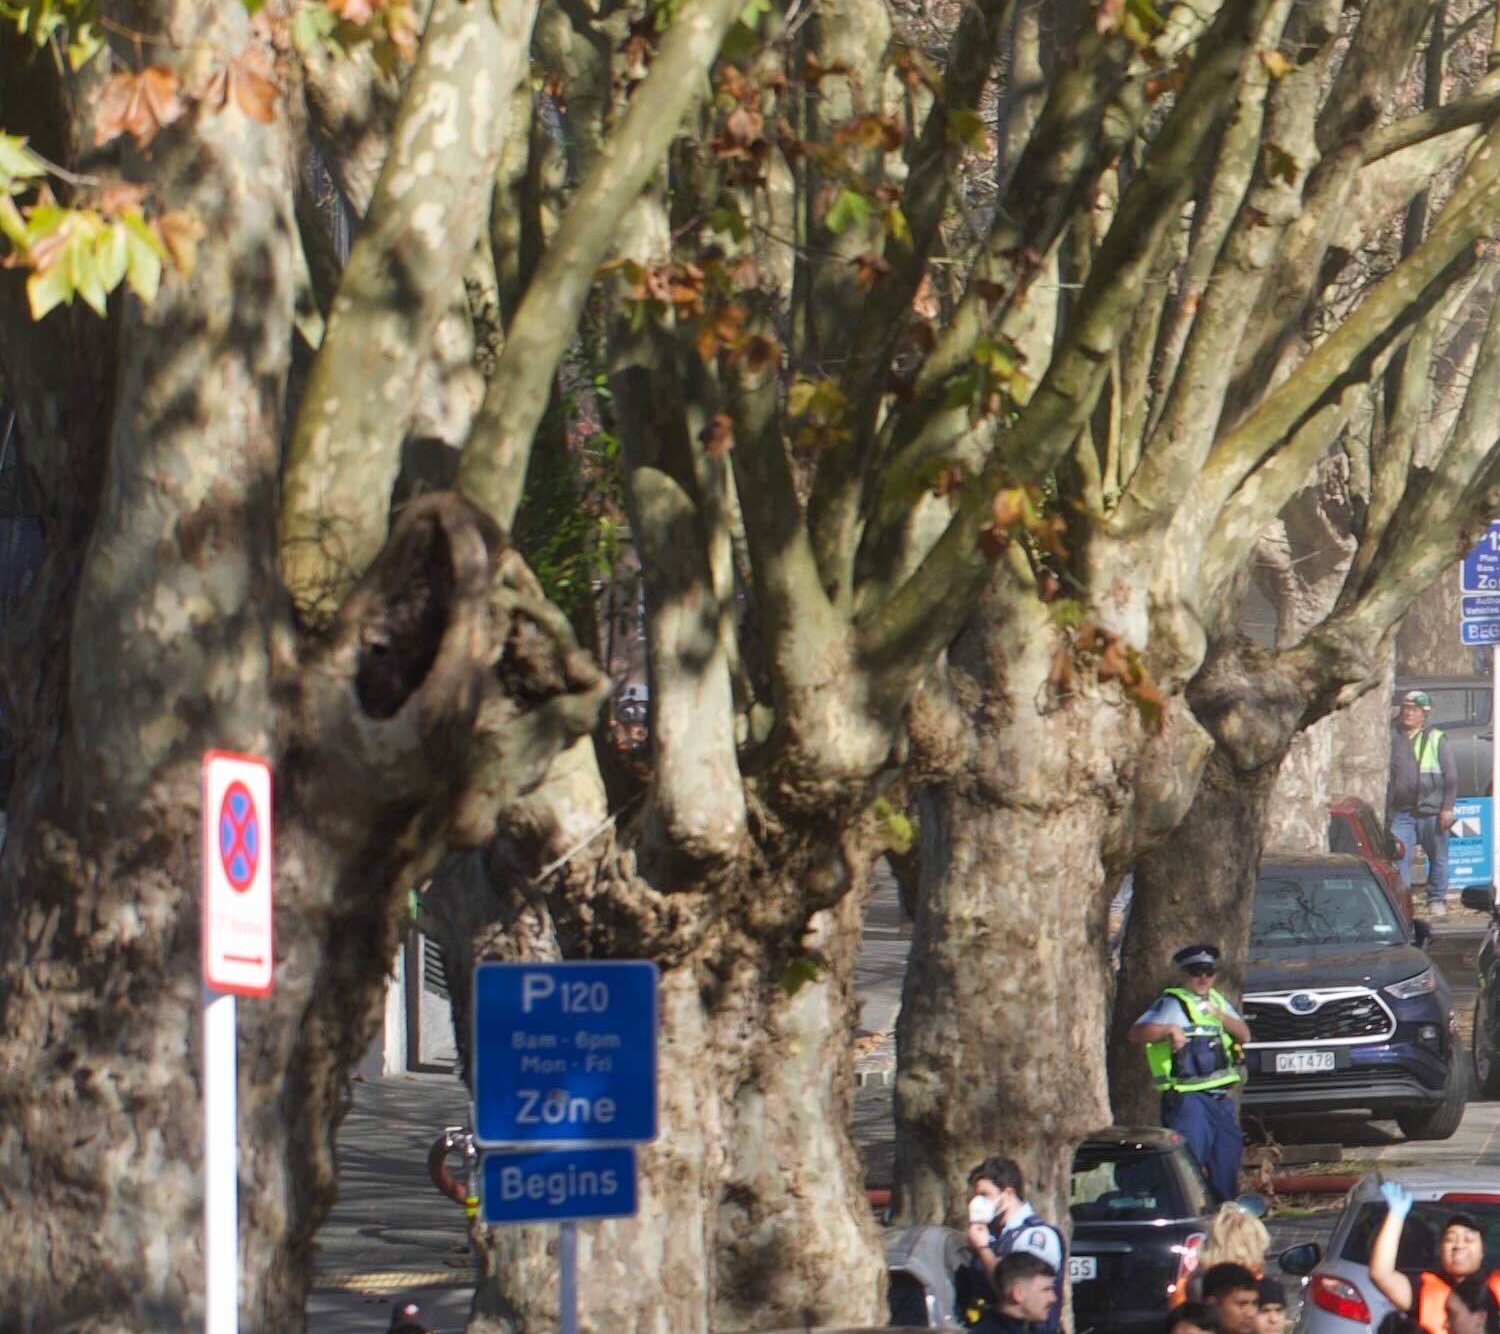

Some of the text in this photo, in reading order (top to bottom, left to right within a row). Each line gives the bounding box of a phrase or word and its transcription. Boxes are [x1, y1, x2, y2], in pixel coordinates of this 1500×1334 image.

[522, 973, 609, 1014] P 120
[512, 1030, 557, 1050] 8am
[574, 1030, 621, 1053] 6pm
[520, 1055, 567, 1073] Mon
[584, 1054, 613, 1073] Fri
[1279, 1053, 1334, 1069] QKT478
[515, 1088, 616, 1125] Zone
[501, 1165, 618, 1205] Begins
